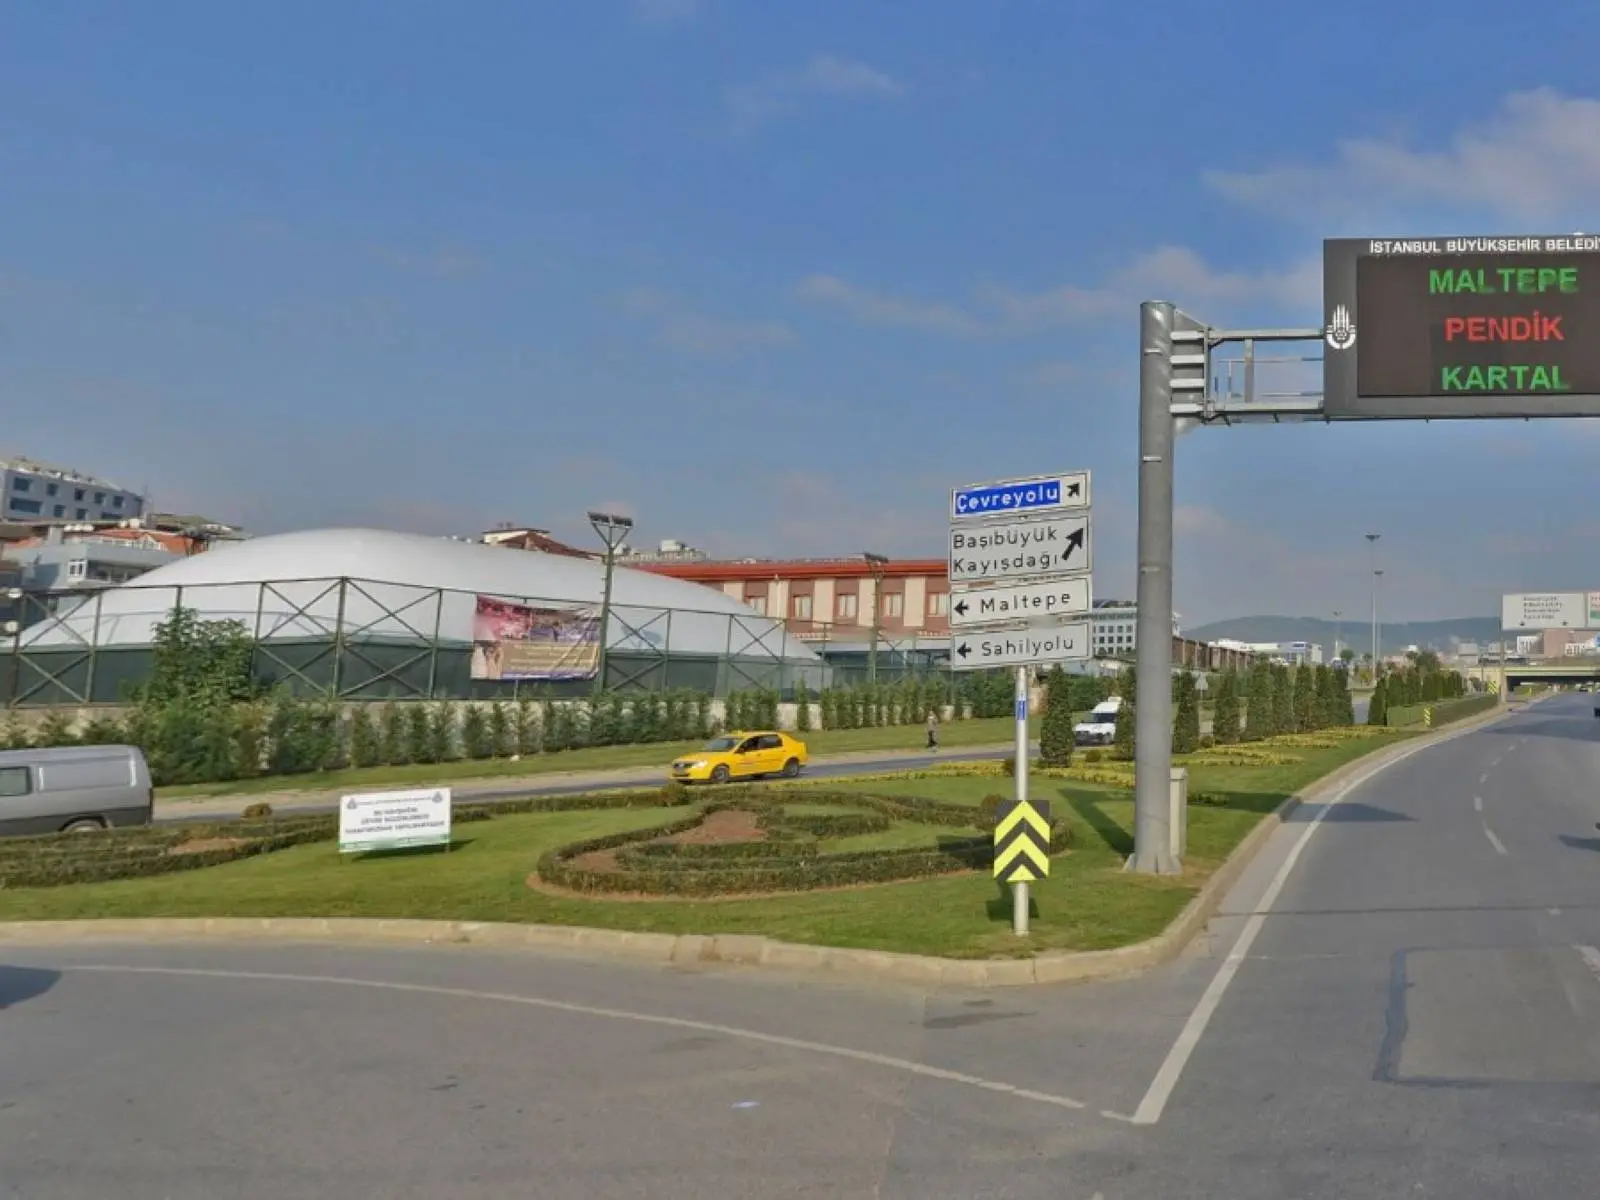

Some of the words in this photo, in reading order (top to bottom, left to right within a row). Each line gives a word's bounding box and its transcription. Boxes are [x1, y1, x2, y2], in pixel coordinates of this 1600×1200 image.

[1370, 239, 1441, 253] İSTANBUL
[1545, 235, 1600, 251] BELEDİ
[1429, 267, 1579, 293] MALTEPE
[1444, 310, 1565, 341] PENDİK
[1442, 365, 1571, 390] KARTAL
[956, 485, 1058, 512] Çevreyolu
[953, 525, 1057, 549] Başıbüyük
[953, 551, 1058, 574] Kayışdağı
[980, 592, 1071, 613] Maltepe
[981, 636, 1073, 656] Sahilyolu
